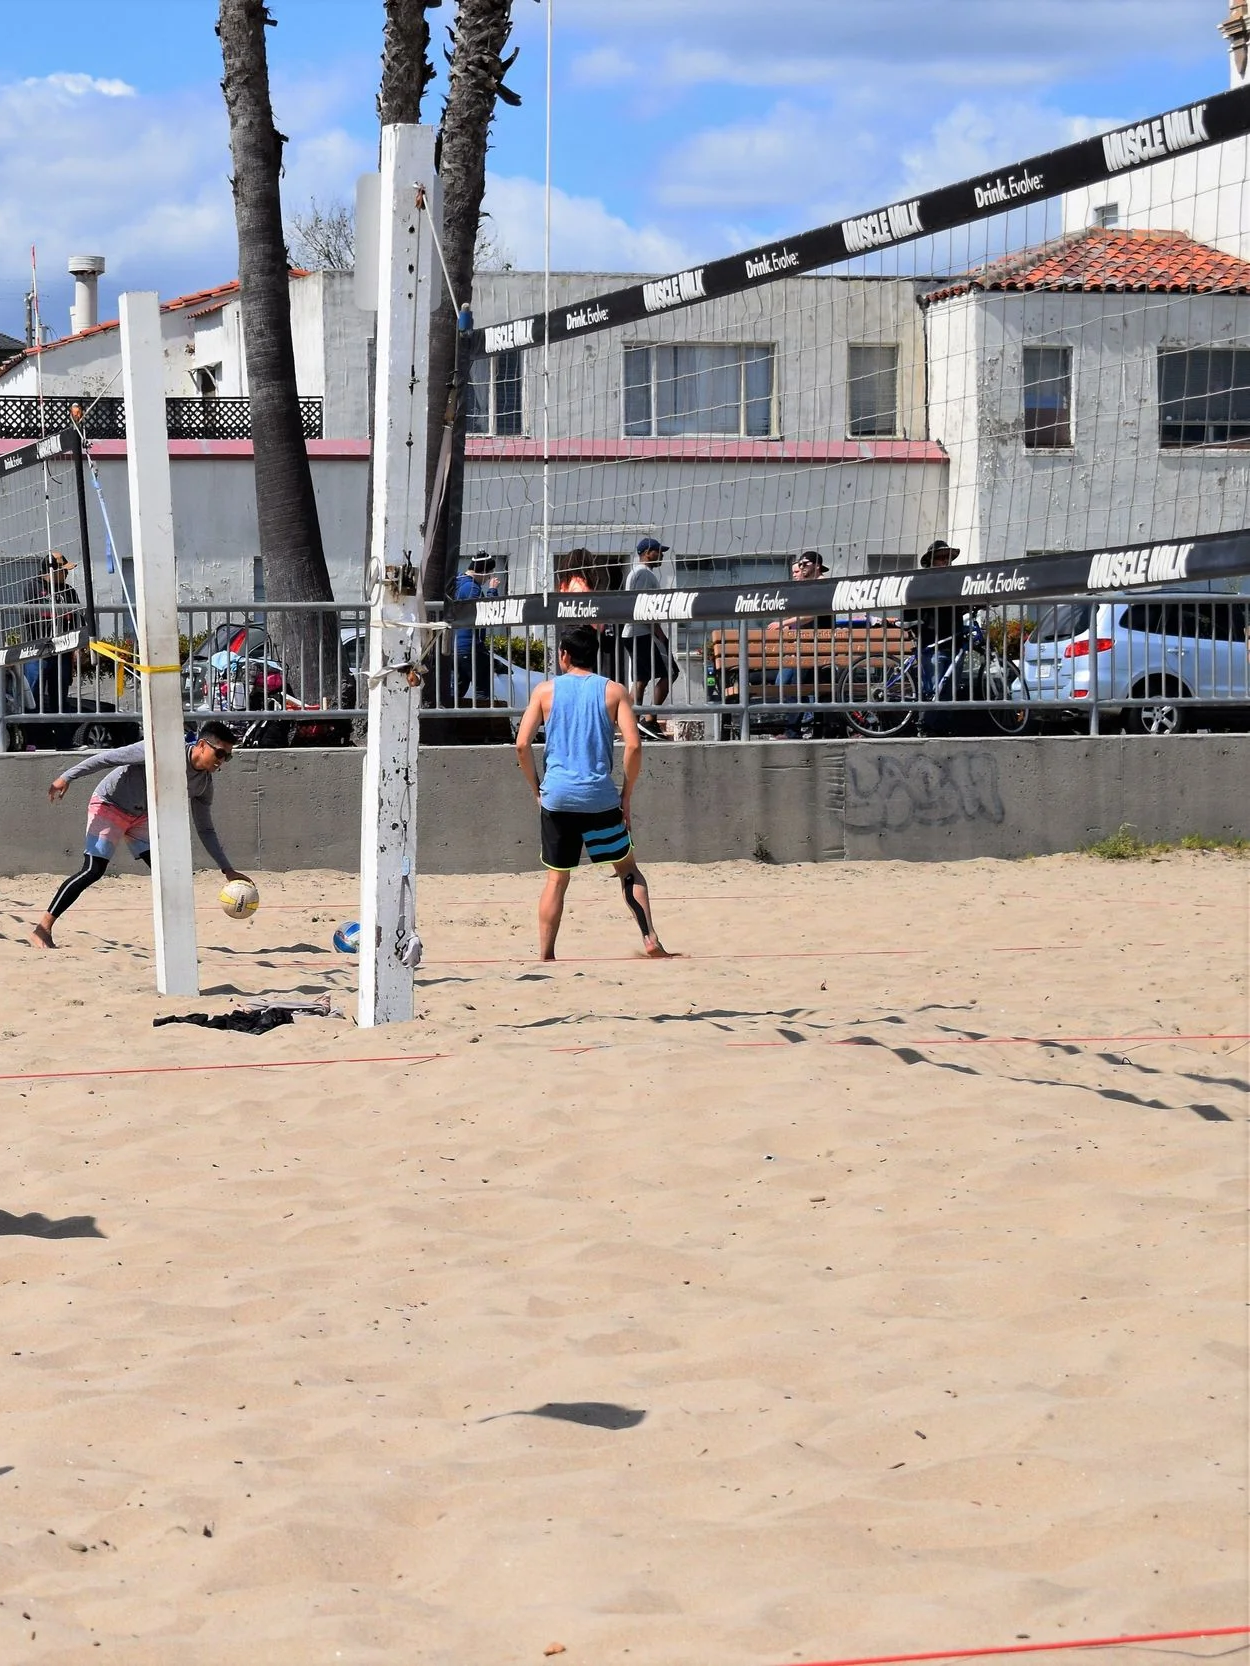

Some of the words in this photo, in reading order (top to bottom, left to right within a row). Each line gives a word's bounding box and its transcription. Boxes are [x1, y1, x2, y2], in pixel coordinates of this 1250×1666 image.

[643, 276, 682, 312] MUSCLE
[679, 269, 707, 301] MILK
[842, 212, 892, 253] MUSCLE
[888, 200, 924, 240] MILK
[1102, 120, 1167, 172] MUSCLE
[1163, 104, 1209, 152] MILK
[633, 593, 672, 620] MUSCLE
[669, 591, 698, 619] MILK
[832, 578, 881, 611] MUSCLE
[877, 575, 914, 607] MILK
[1087, 549, 1150, 589] MUSCLE
[1147, 543, 1194, 582] MILK
